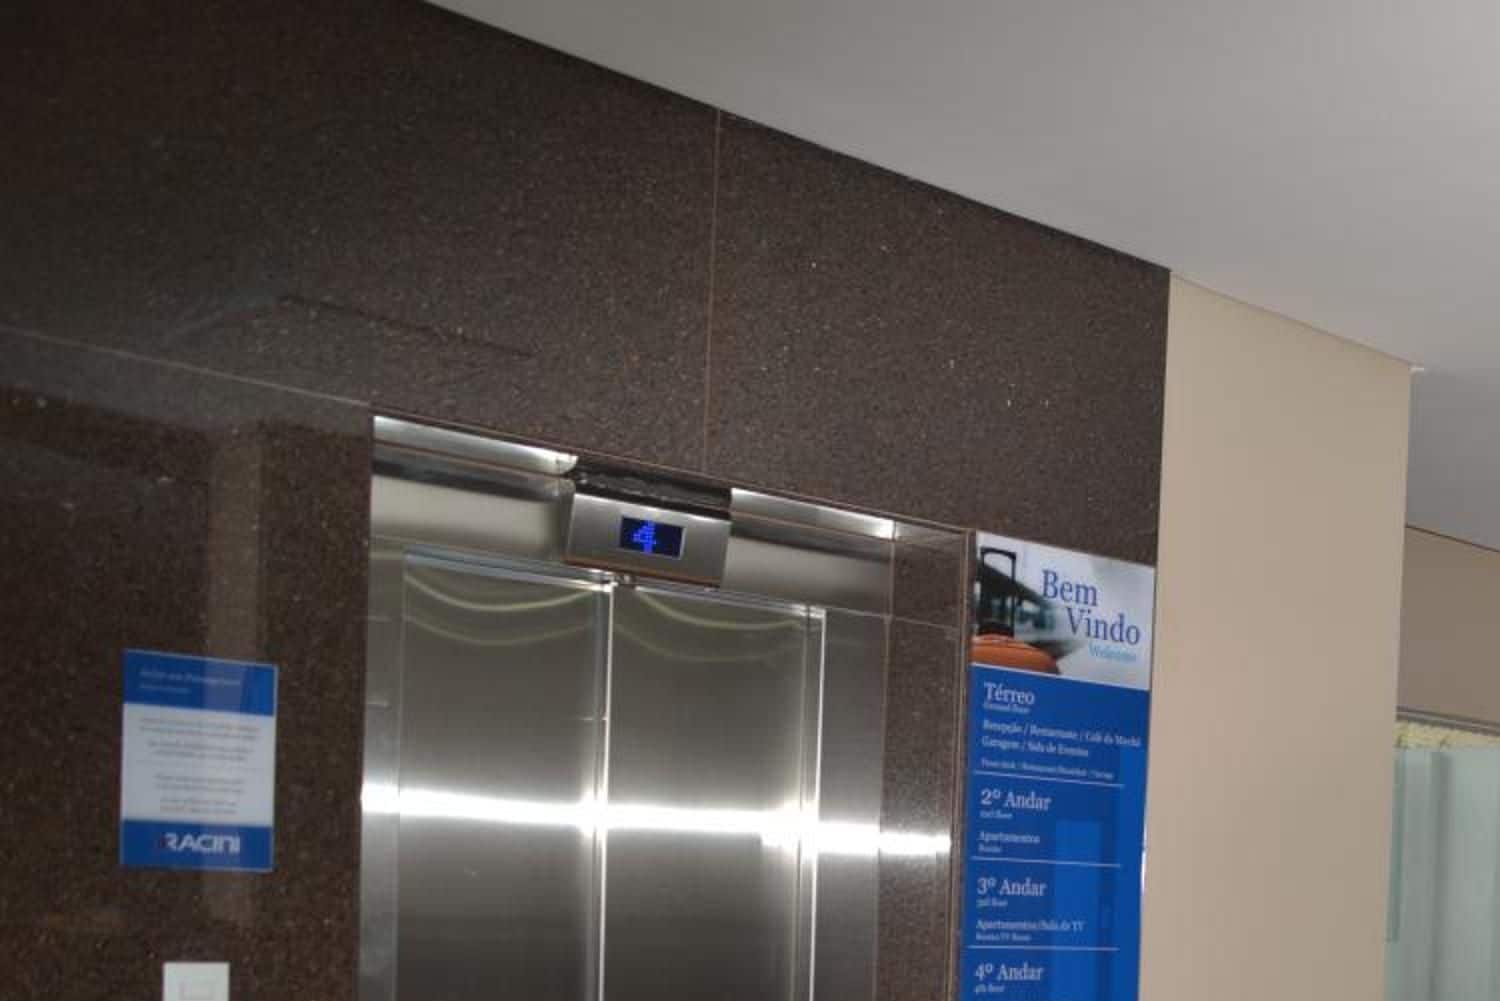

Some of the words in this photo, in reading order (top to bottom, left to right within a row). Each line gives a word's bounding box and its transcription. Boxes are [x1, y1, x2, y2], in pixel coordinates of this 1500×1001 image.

[632, 518, 656, 553] 4
[1041, 569, 1099, 608] Bem
[1066, 606, 1141, 646] Vindo
[983, 681, 1036, 705] Térreo
[1003, 790, 1052, 811] Andar
[1000, 877, 1048, 897] Andar
[996, 962, 1044, 981] Andar
